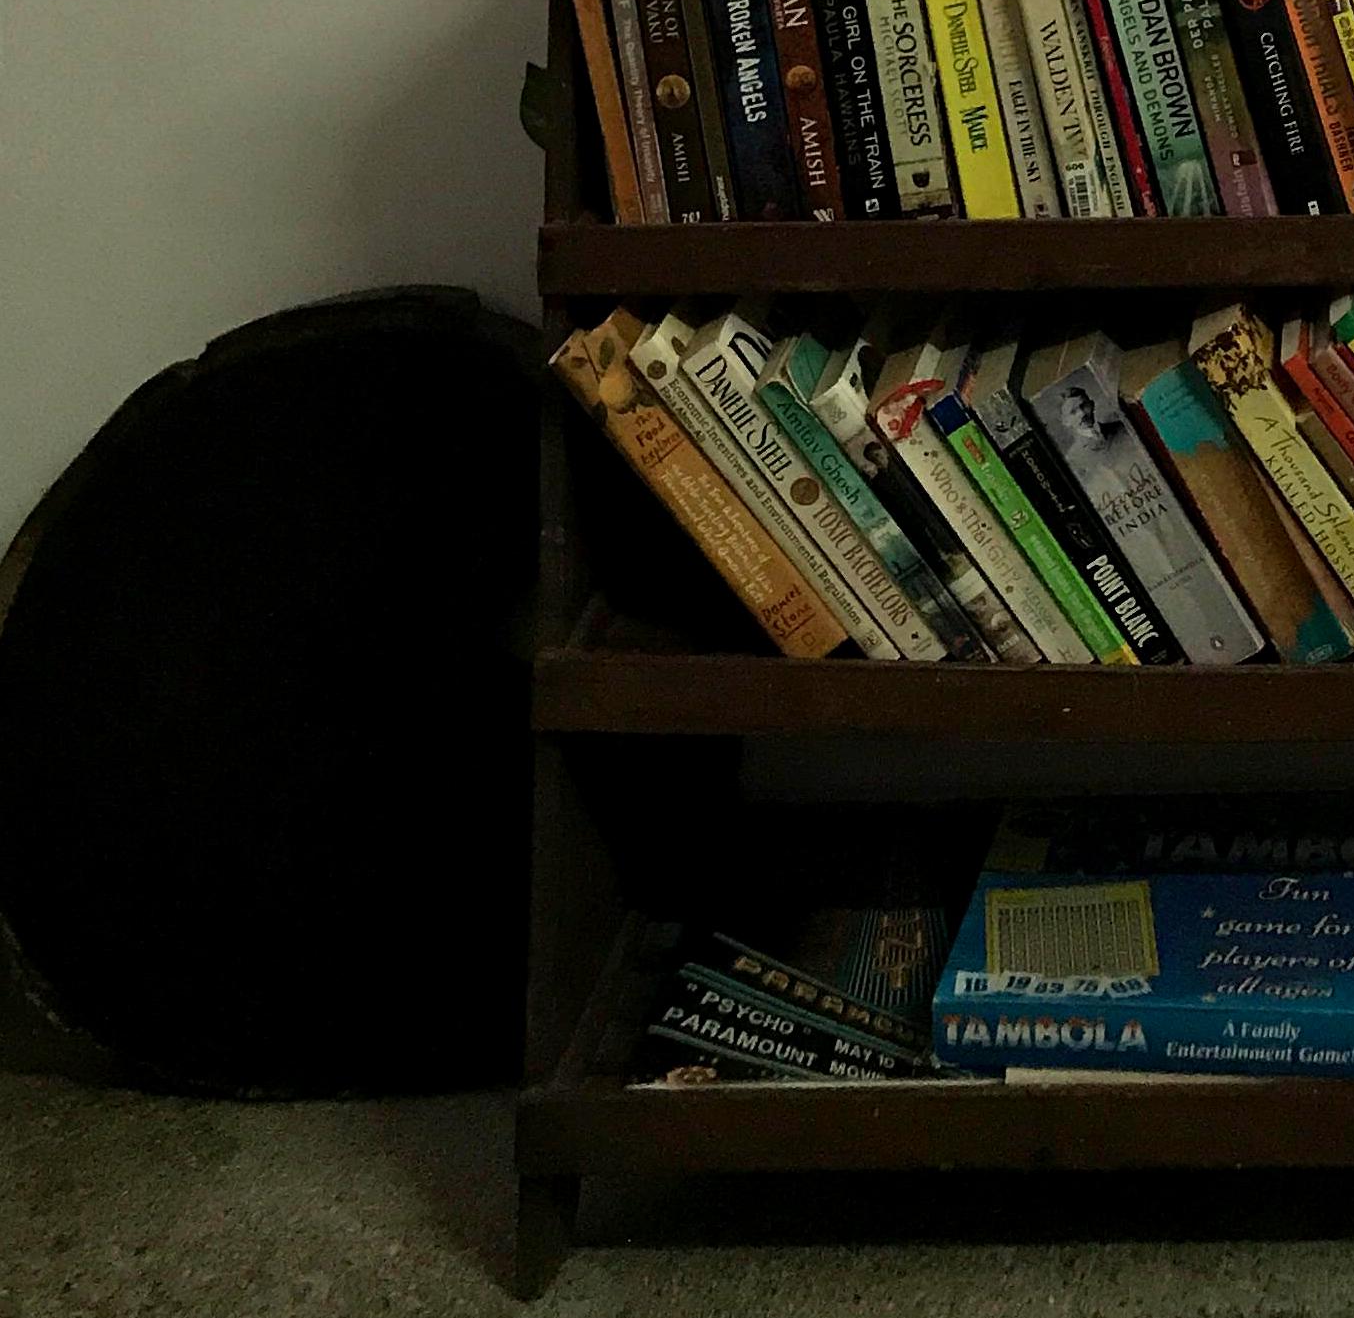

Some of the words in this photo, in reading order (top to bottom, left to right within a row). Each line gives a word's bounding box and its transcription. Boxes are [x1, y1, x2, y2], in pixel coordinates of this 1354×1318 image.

[842, 5, 860, 50] GIRL
[1187, 18, 1204, 49] DER
[736, 57, 768, 125] ANGELS
[850, 55, 867, 84] ON
[893, 22, 932, 147] SORCERESS
[1040, 19, 1078, 116] WALDEN
[1153, 48, 1196, 139] BROWN
[1260, 31, 1295, 116] CATCHING
[1283, 118, 1305, 157] FIRE
[832, 72, 860, 166] HAWKINS
[856, 88, 875, 128] THE
[1132, 50, 1152, 85] AND
[1142, 88, 1174, 162] DEMONS
[671, 131, 691, 183] AMISH
[799, 116, 827, 187] AMISH
[860, 130, 886, 189] TRAIN
[776, 400, 822, 456] Amitav
[819, 452, 861, 507] Ghosh
[1255, 416, 1280, 432] A
[1269, 431, 1322, 502] Thousand
[666, 377, 712, 429] Economic
[704, 425, 751, 479] Incentives
[759, 496, 824, 572] Environmental
[816, 569, 865, 626] Regulation
[1102, 484, 1165, 527] BEFORE
[1265, 454, 1316, 525] KHALED
[1119, 503, 1169, 537] INDIA
[811, 503, 847, 553] TOXIC
[843, 547, 915, 628] BACHELORS
[1086, 554, 1131, 606] POINT
[1114, 596, 1160, 649] BLANC
[1258, 877, 1331, 901] Fun
[1215, 919, 1301, 938] game
[1197, 945, 1322, 970] players
[1216, 975, 1265, 995] all
[661, 1005, 819, 1067] PARAMOUNT
[700, 989, 796, 1035] PSYCHO
[943, 1013, 1148, 1053] TAMBOLA
[1222, 1020, 1236, 1038] A
[1241, 1021, 1301, 1043] Family
[834, 1038, 875, 1064] MAY
[1166, 1041, 1293, 1063] Entertainment
